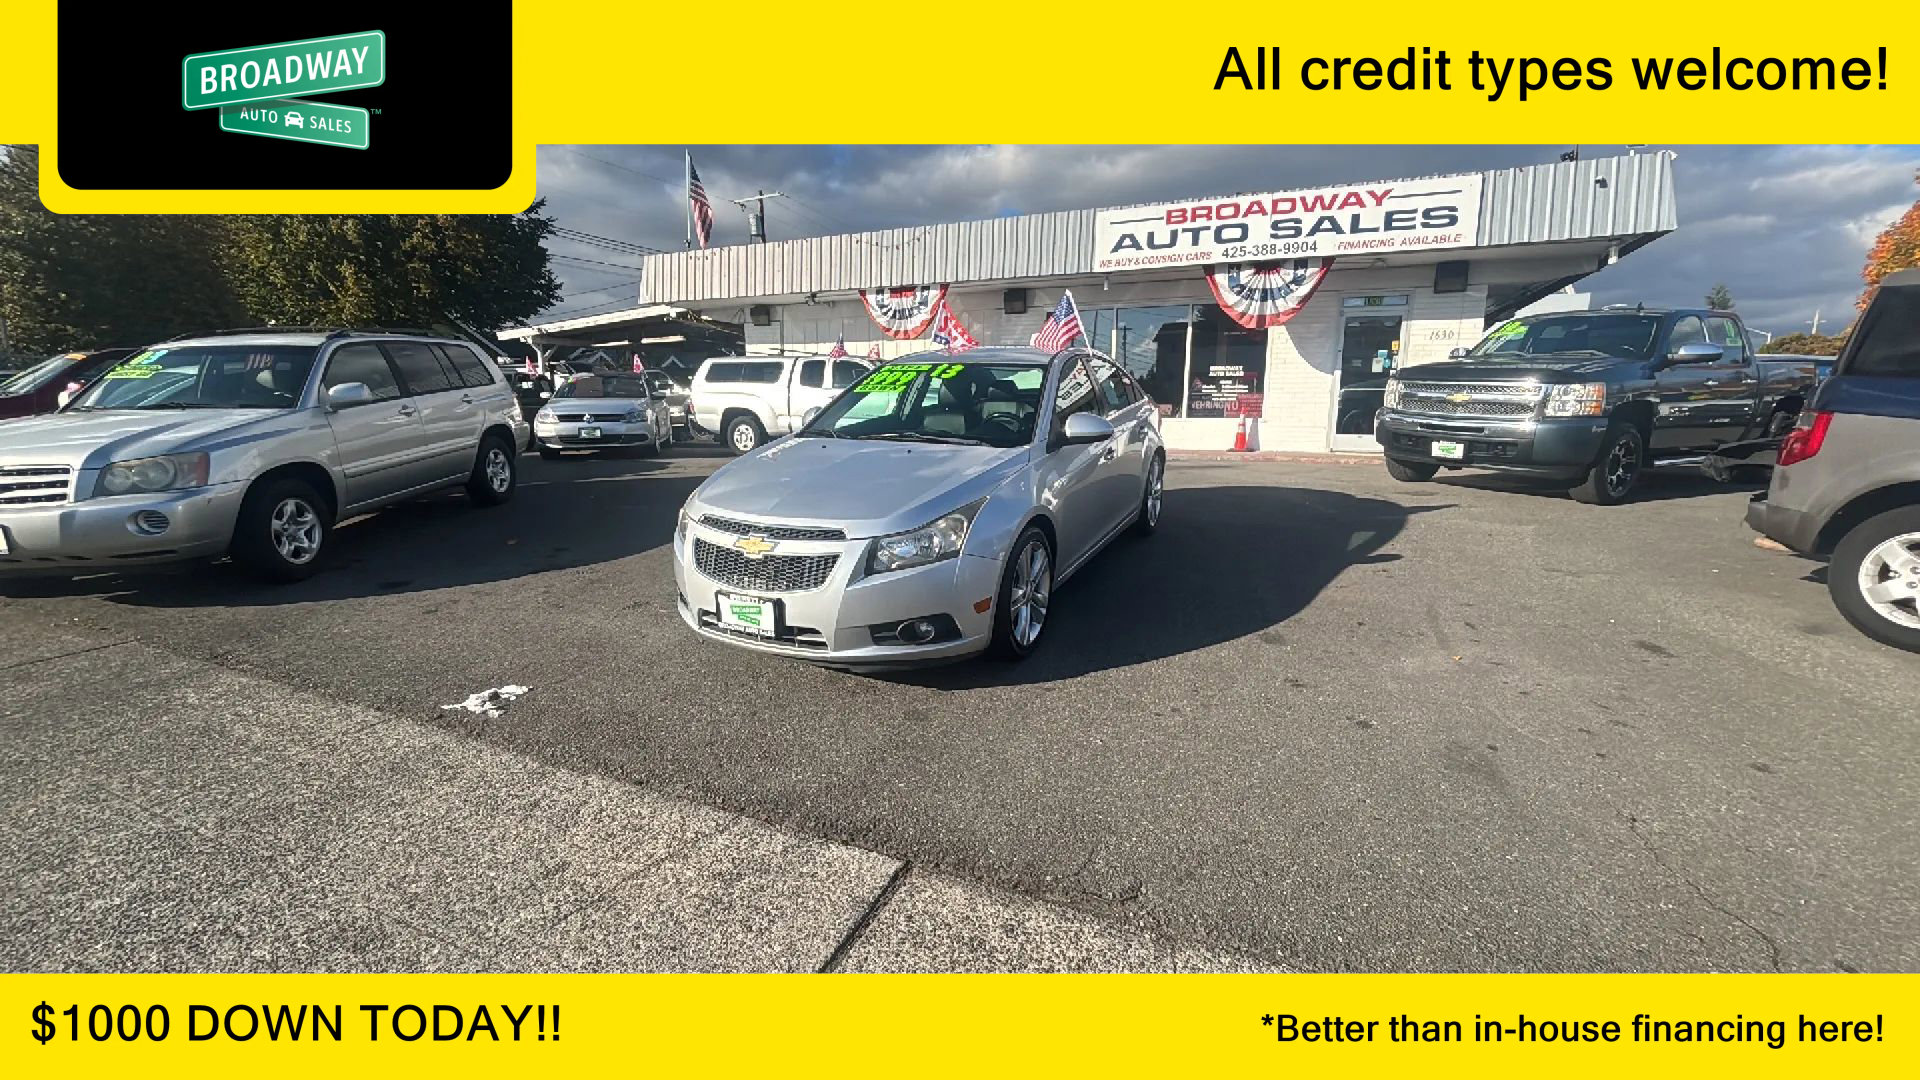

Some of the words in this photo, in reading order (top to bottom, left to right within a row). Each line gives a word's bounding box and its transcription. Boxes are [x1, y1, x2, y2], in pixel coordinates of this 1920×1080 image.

[1165, 188, 1394, 225] BROADWAY
[1110, 223, 1249, 254] AUTO
[1270, 205, 1459, 240] SALES
[1222, 240, 1318, 259] 425-388-9904
[1338, 238, 1395, 251] FINANCING
[1400, 234, 1462, 247] AVAILABLE
[1099, 259, 1112, 269] WE
[1114, 258, 1134, 267] BUY
[1142, 254, 1184, 265] CONSIGN
[1186, 251, 1213, 261] CARS
[1429, 329, 1455, 341] 1630
